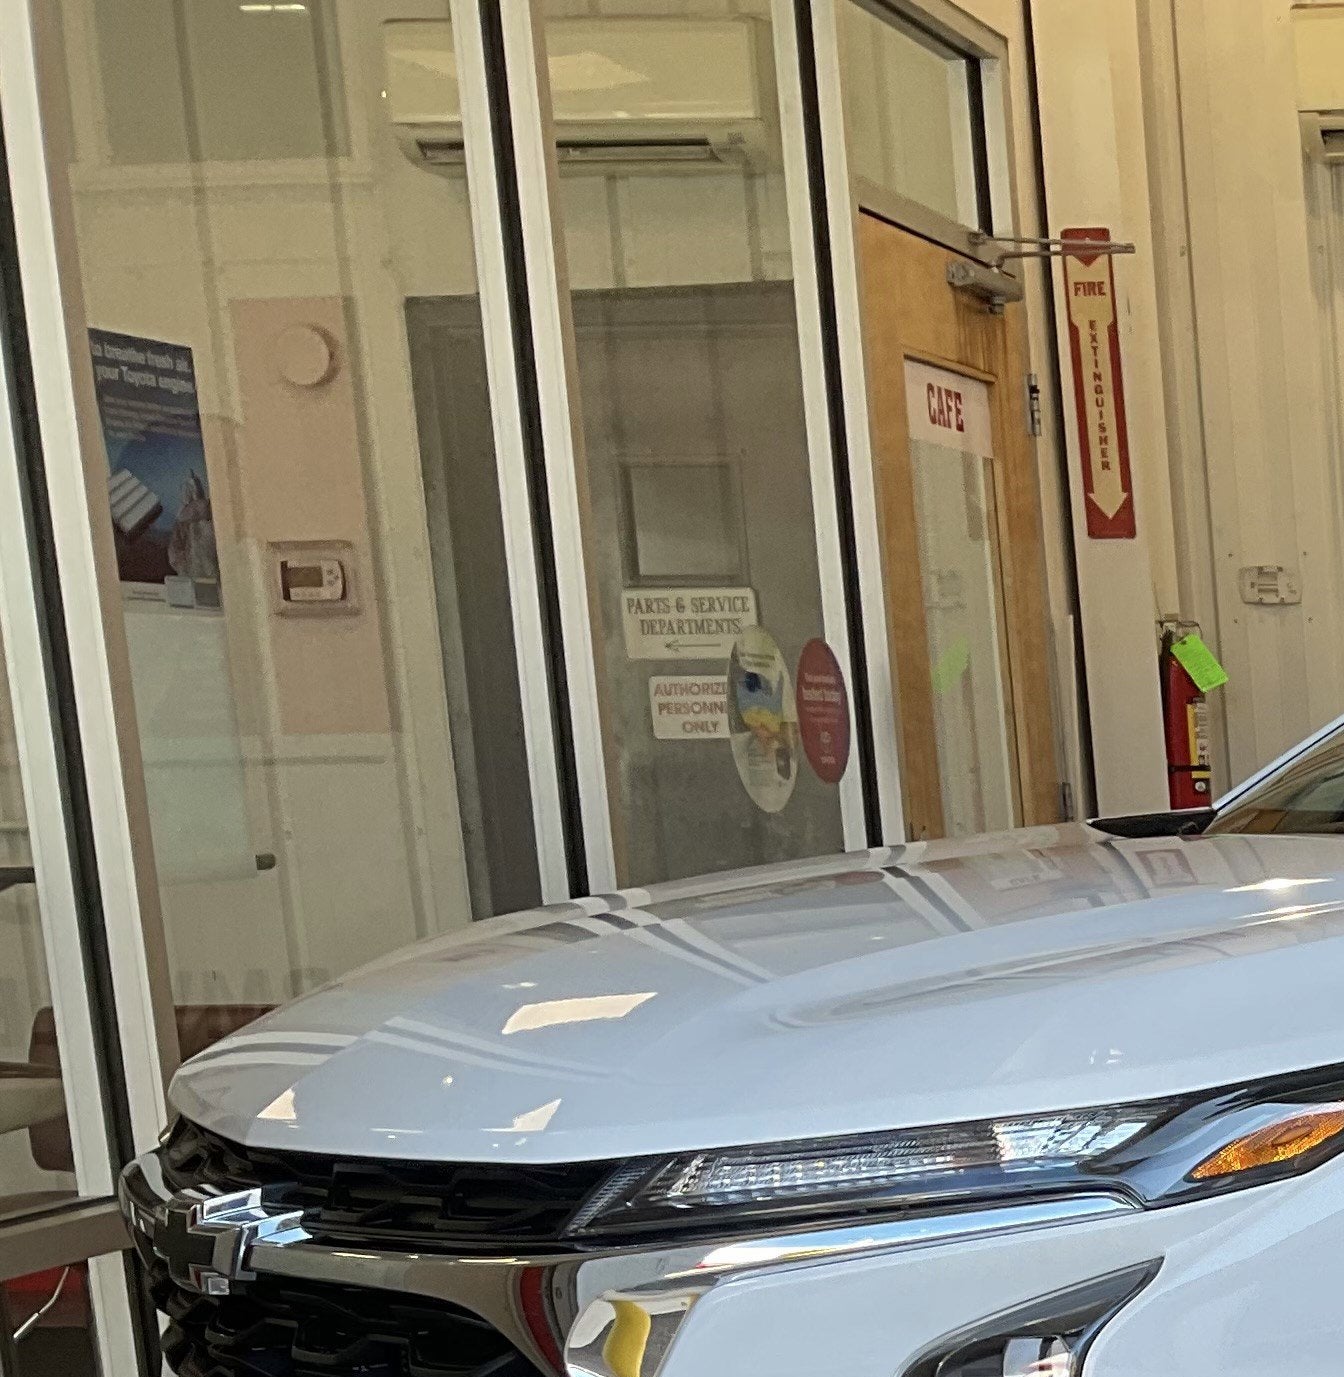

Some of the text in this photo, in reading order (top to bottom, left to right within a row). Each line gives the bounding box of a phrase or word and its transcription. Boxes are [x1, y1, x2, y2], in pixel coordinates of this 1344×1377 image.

[1073, 281, 1107, 297] FIRE
[1087, 319, 1111, 471] EXTINGUISHER
[926, 382, 965, 432] CAFE
[627, 597, 671, 614] PARTS
[690, 596, 750, 614] SERVICE
[639, 618, 743, 636] DEPARTMENTS
[681, 720, 720, 734] ONLY
